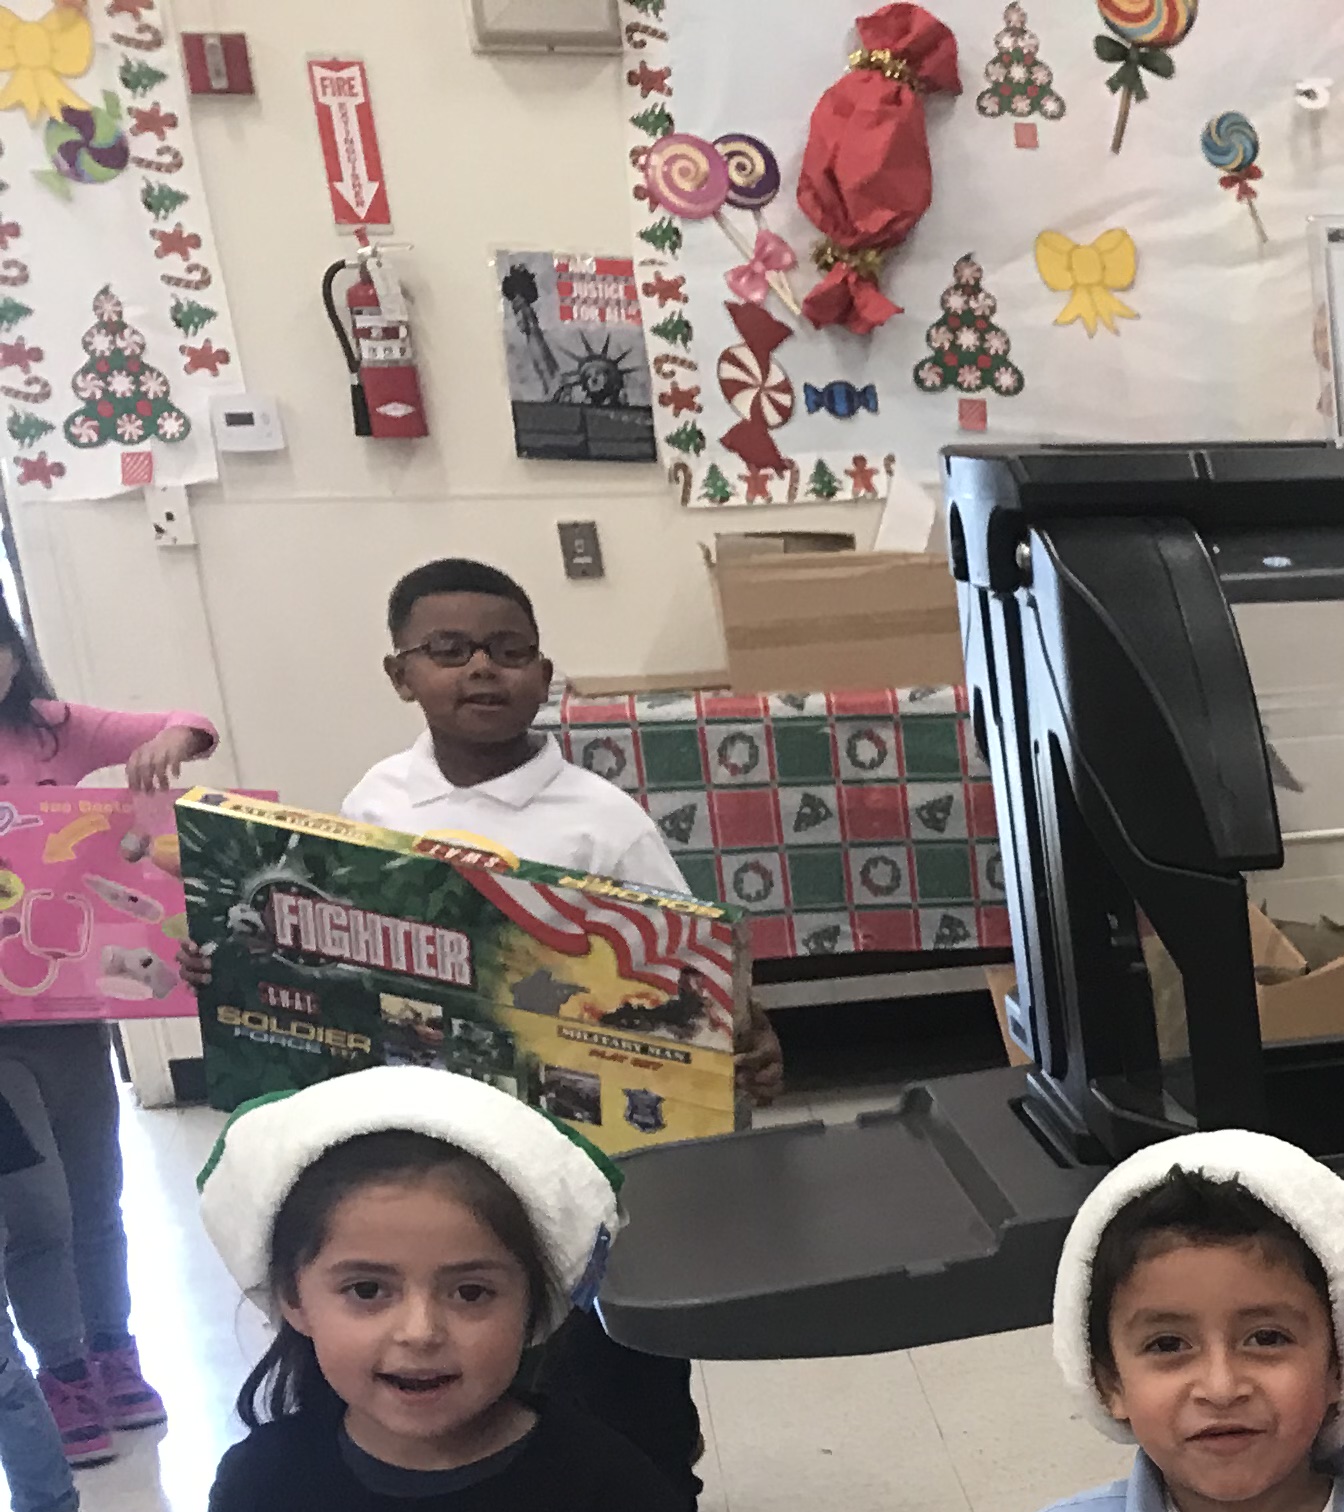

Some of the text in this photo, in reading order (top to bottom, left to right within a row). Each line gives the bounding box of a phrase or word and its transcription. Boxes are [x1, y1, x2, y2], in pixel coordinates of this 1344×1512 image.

[319, 76, 359, 98] FIRE
[572, 281, 624, 300] JUSTICE
[271, 891, 473, 986] FIGHTER
[217, 1005, 372, 1054] SOLDIER
